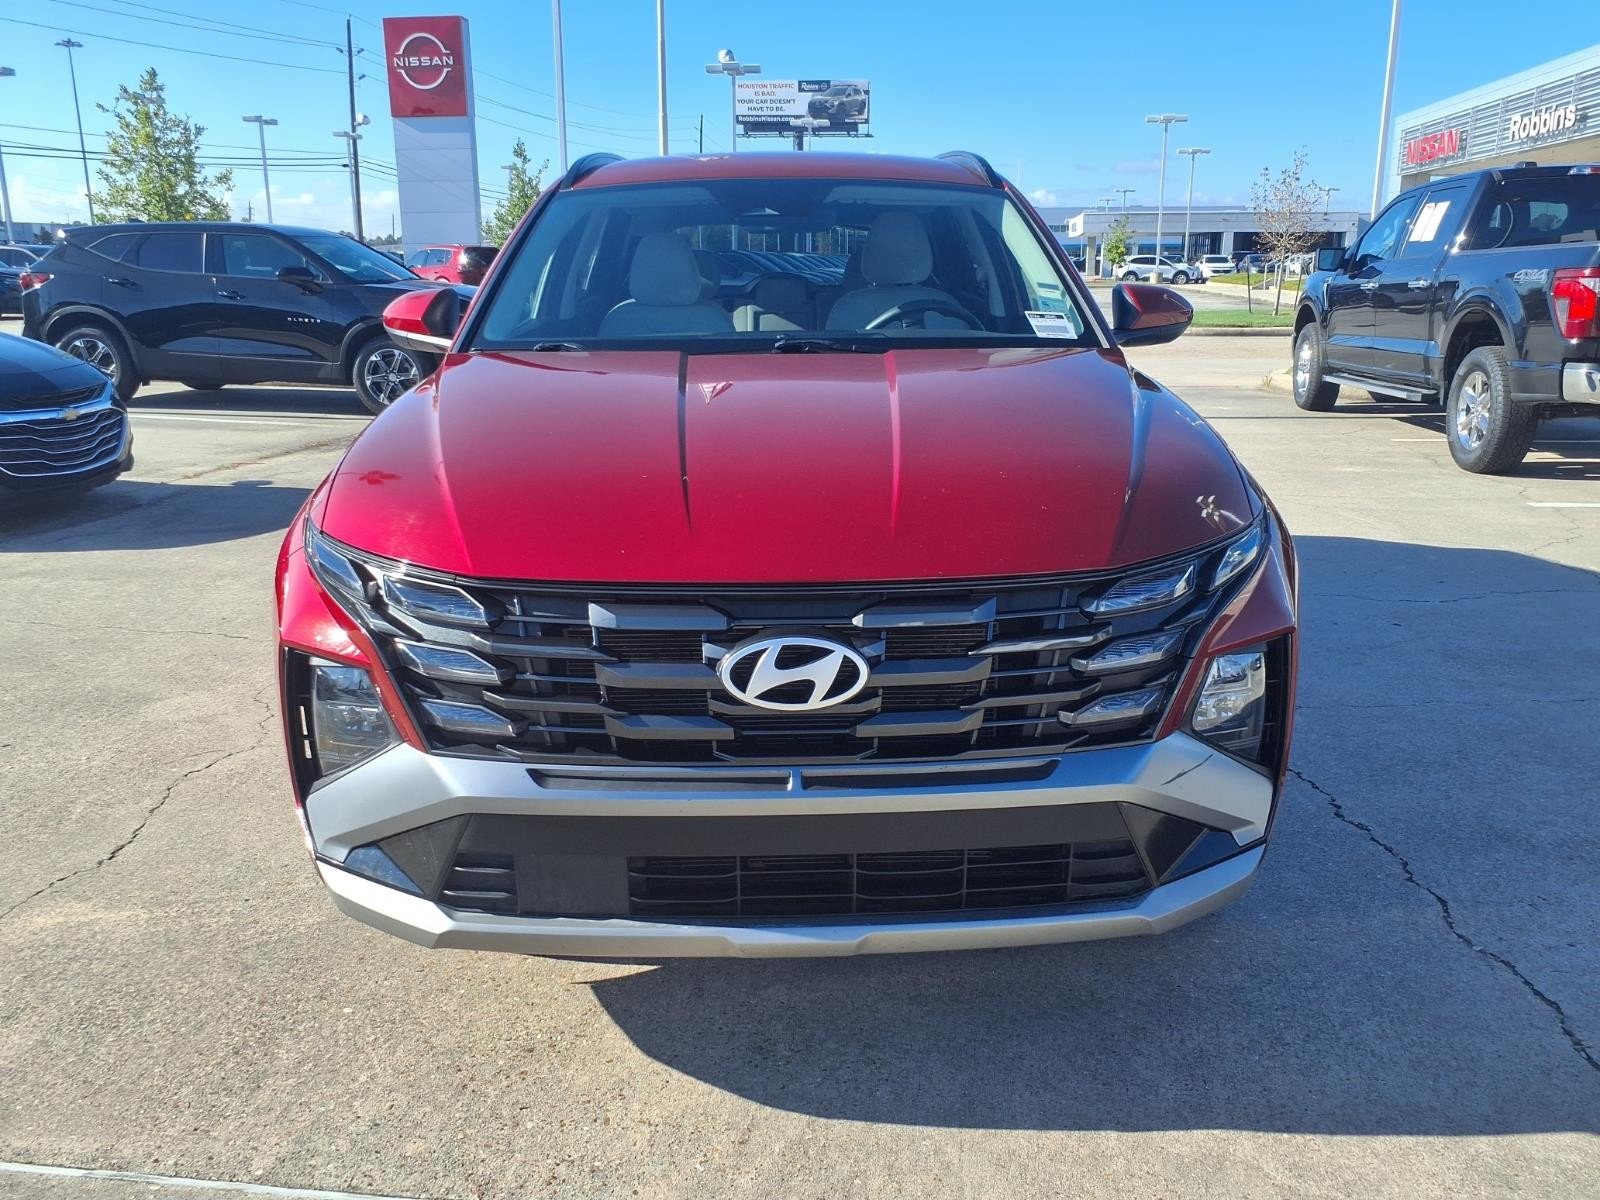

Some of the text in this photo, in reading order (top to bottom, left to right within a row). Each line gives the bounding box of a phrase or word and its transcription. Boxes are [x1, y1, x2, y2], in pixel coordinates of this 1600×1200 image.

[394, 56, 453, 67] NISSAN
[1508, 104, 1577, 141] Robbins
[1406, 128, 1461, 165] NISSAN
